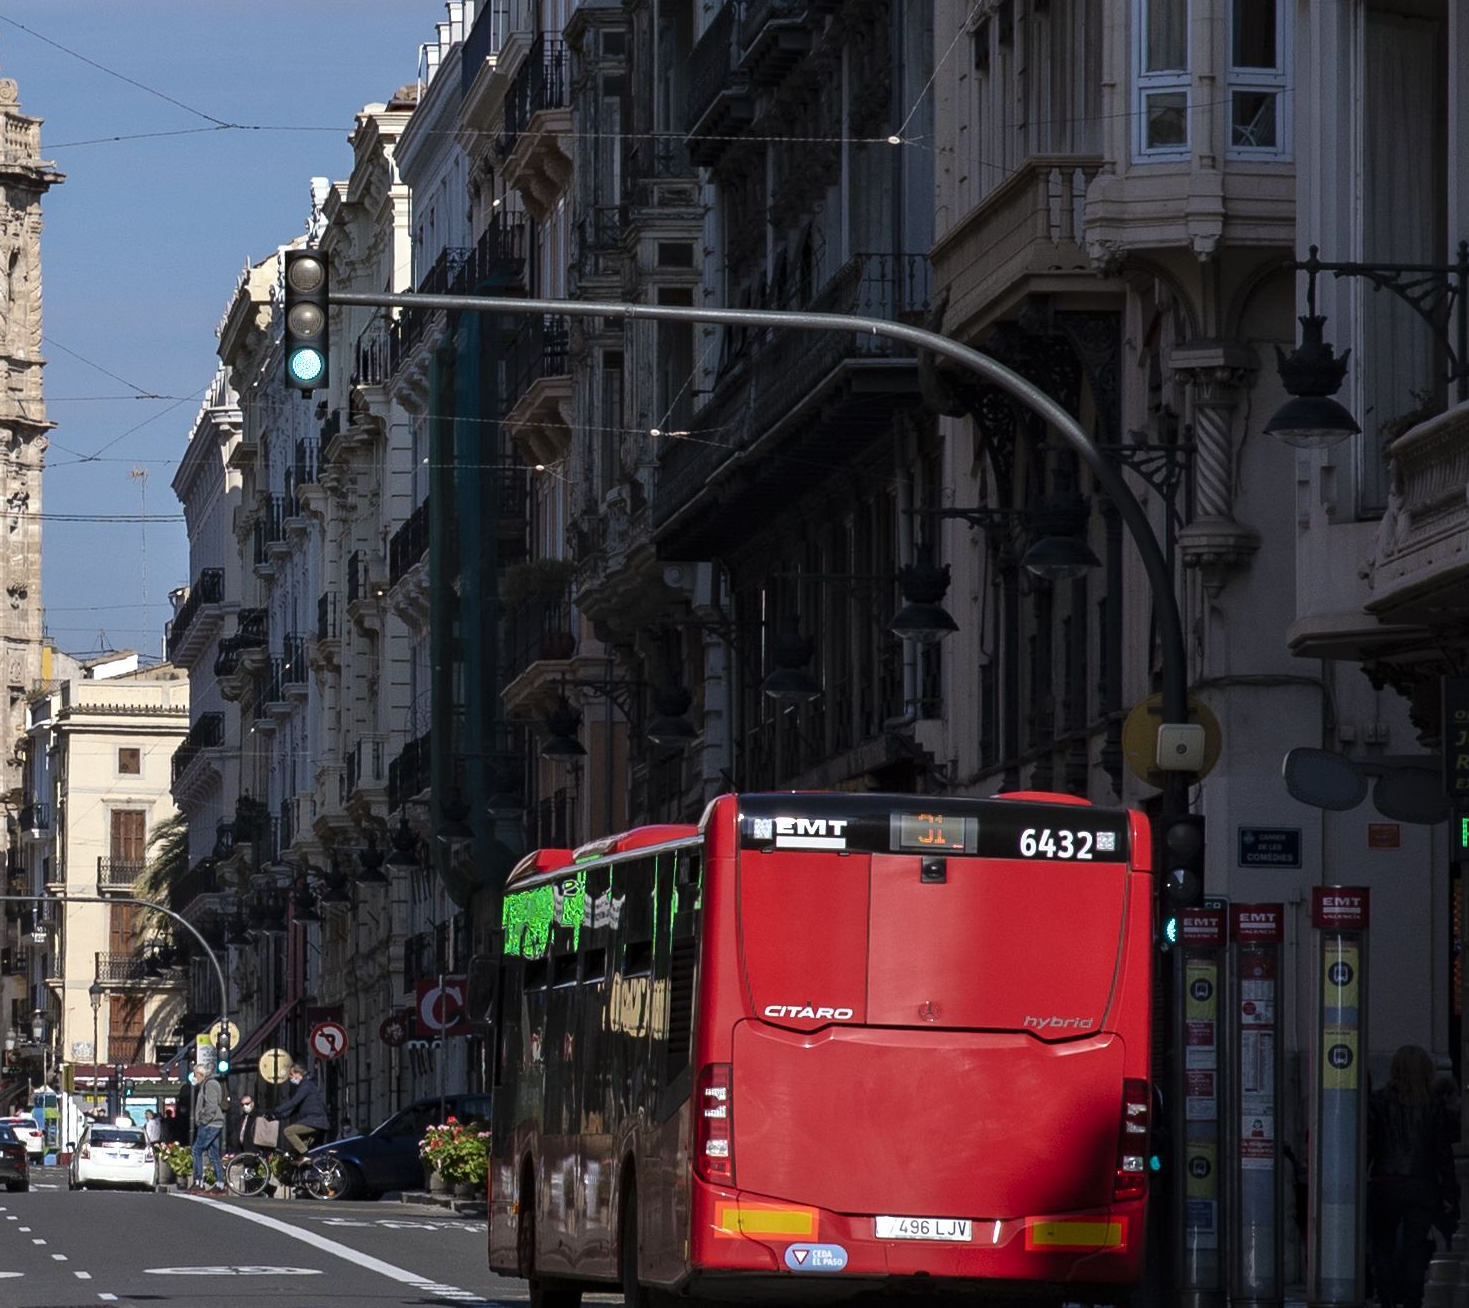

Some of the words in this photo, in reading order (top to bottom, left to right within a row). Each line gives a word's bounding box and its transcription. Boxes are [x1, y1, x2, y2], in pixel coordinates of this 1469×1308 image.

[775, 817, 848, 836] EMT
[1019, 828, 1094, 860] 6432
[1322, 897, 1361, 906] EMT
[1183, 917, 1219, 927] EMT
[1239, 912, 1276, 922] EMT
[764, 1005, 854, 1020] CITARO
[1023, 1014, 1094, 1030] hybrid
[889, 1218, 931, 1235] 496
[935, 1219, 967, 1237] LJV
[812, 1249, 834, 1259] CEDA
[812, 1258, 822, 1266] EL
[822, 1258, 844, 1267] PASO
